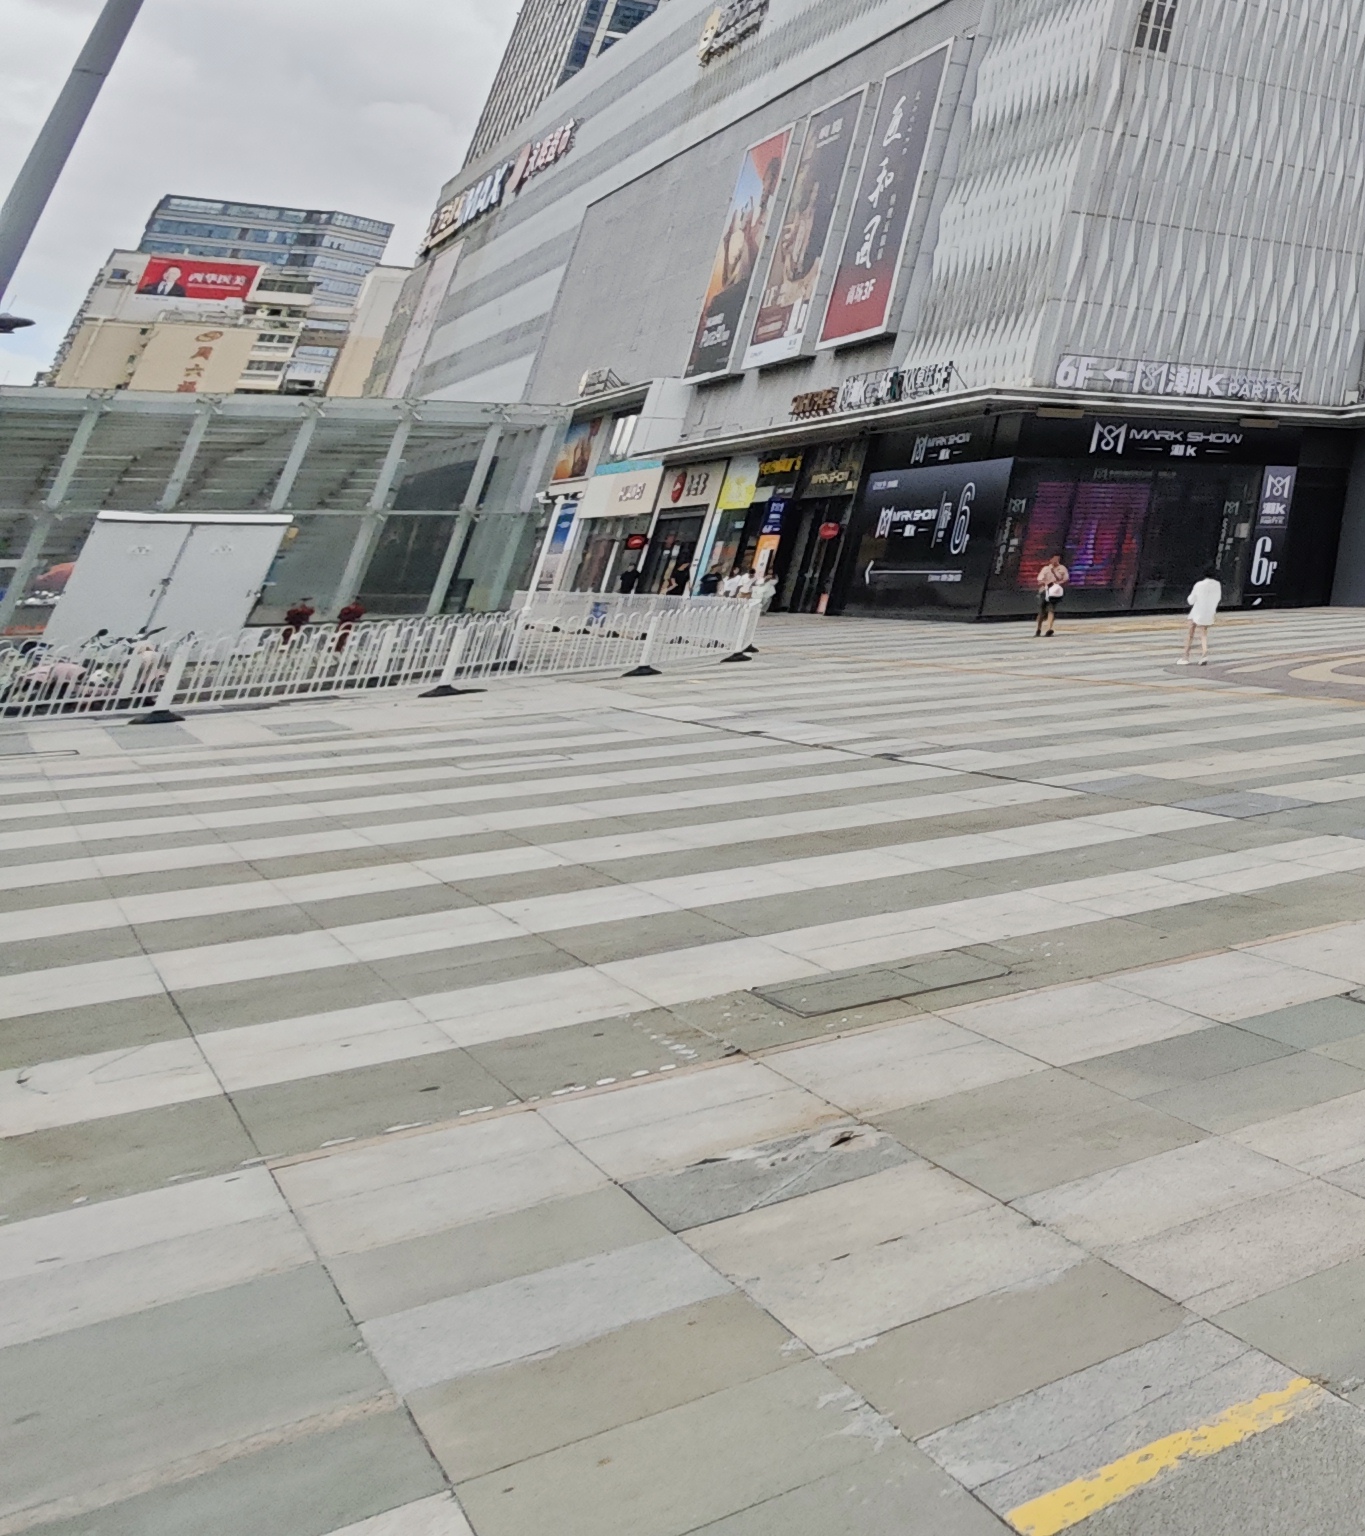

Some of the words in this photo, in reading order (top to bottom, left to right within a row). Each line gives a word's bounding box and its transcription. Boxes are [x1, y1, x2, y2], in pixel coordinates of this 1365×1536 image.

[1056, 355, 1099, 389] 6F
[1129, 428, 1184, 442] MARK
[1186, 431, 1243, 444] SHOW
[1250, 536, 1277, 586] 6F
